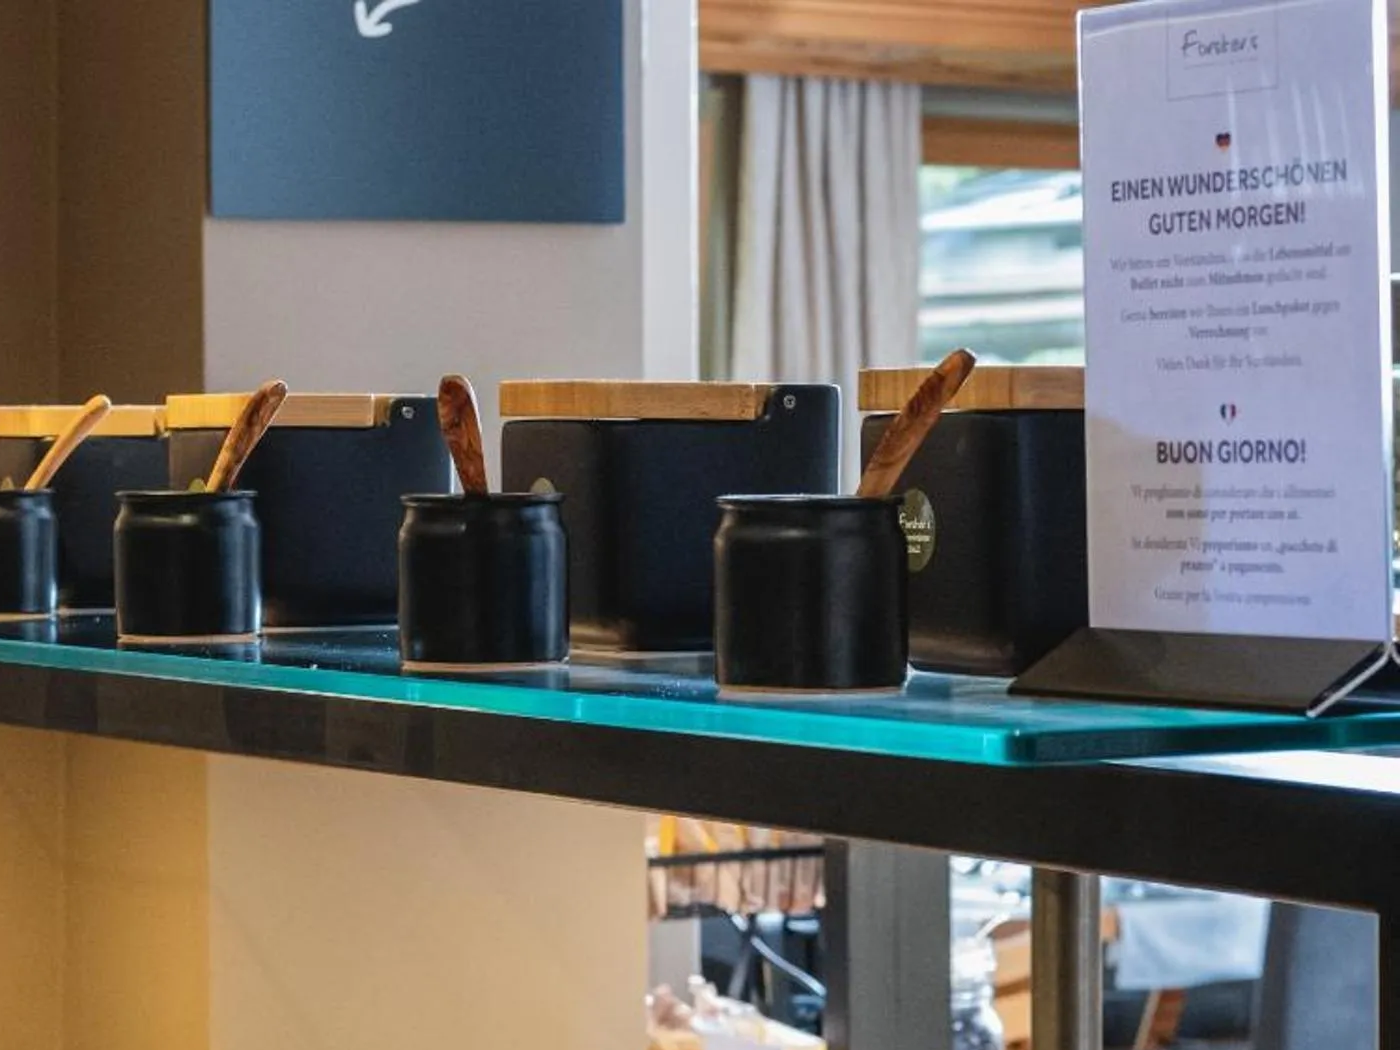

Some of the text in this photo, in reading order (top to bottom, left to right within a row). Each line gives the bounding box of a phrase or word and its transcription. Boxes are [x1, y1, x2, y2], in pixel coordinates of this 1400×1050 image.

[1110, 157, 1348, 203] EINEN WUNDERSCHÖNEN
[1149, 201, 1306, 236] GUTEN MORGEN!
[1156, 439, 1307, 465] BUON GIORNO!
